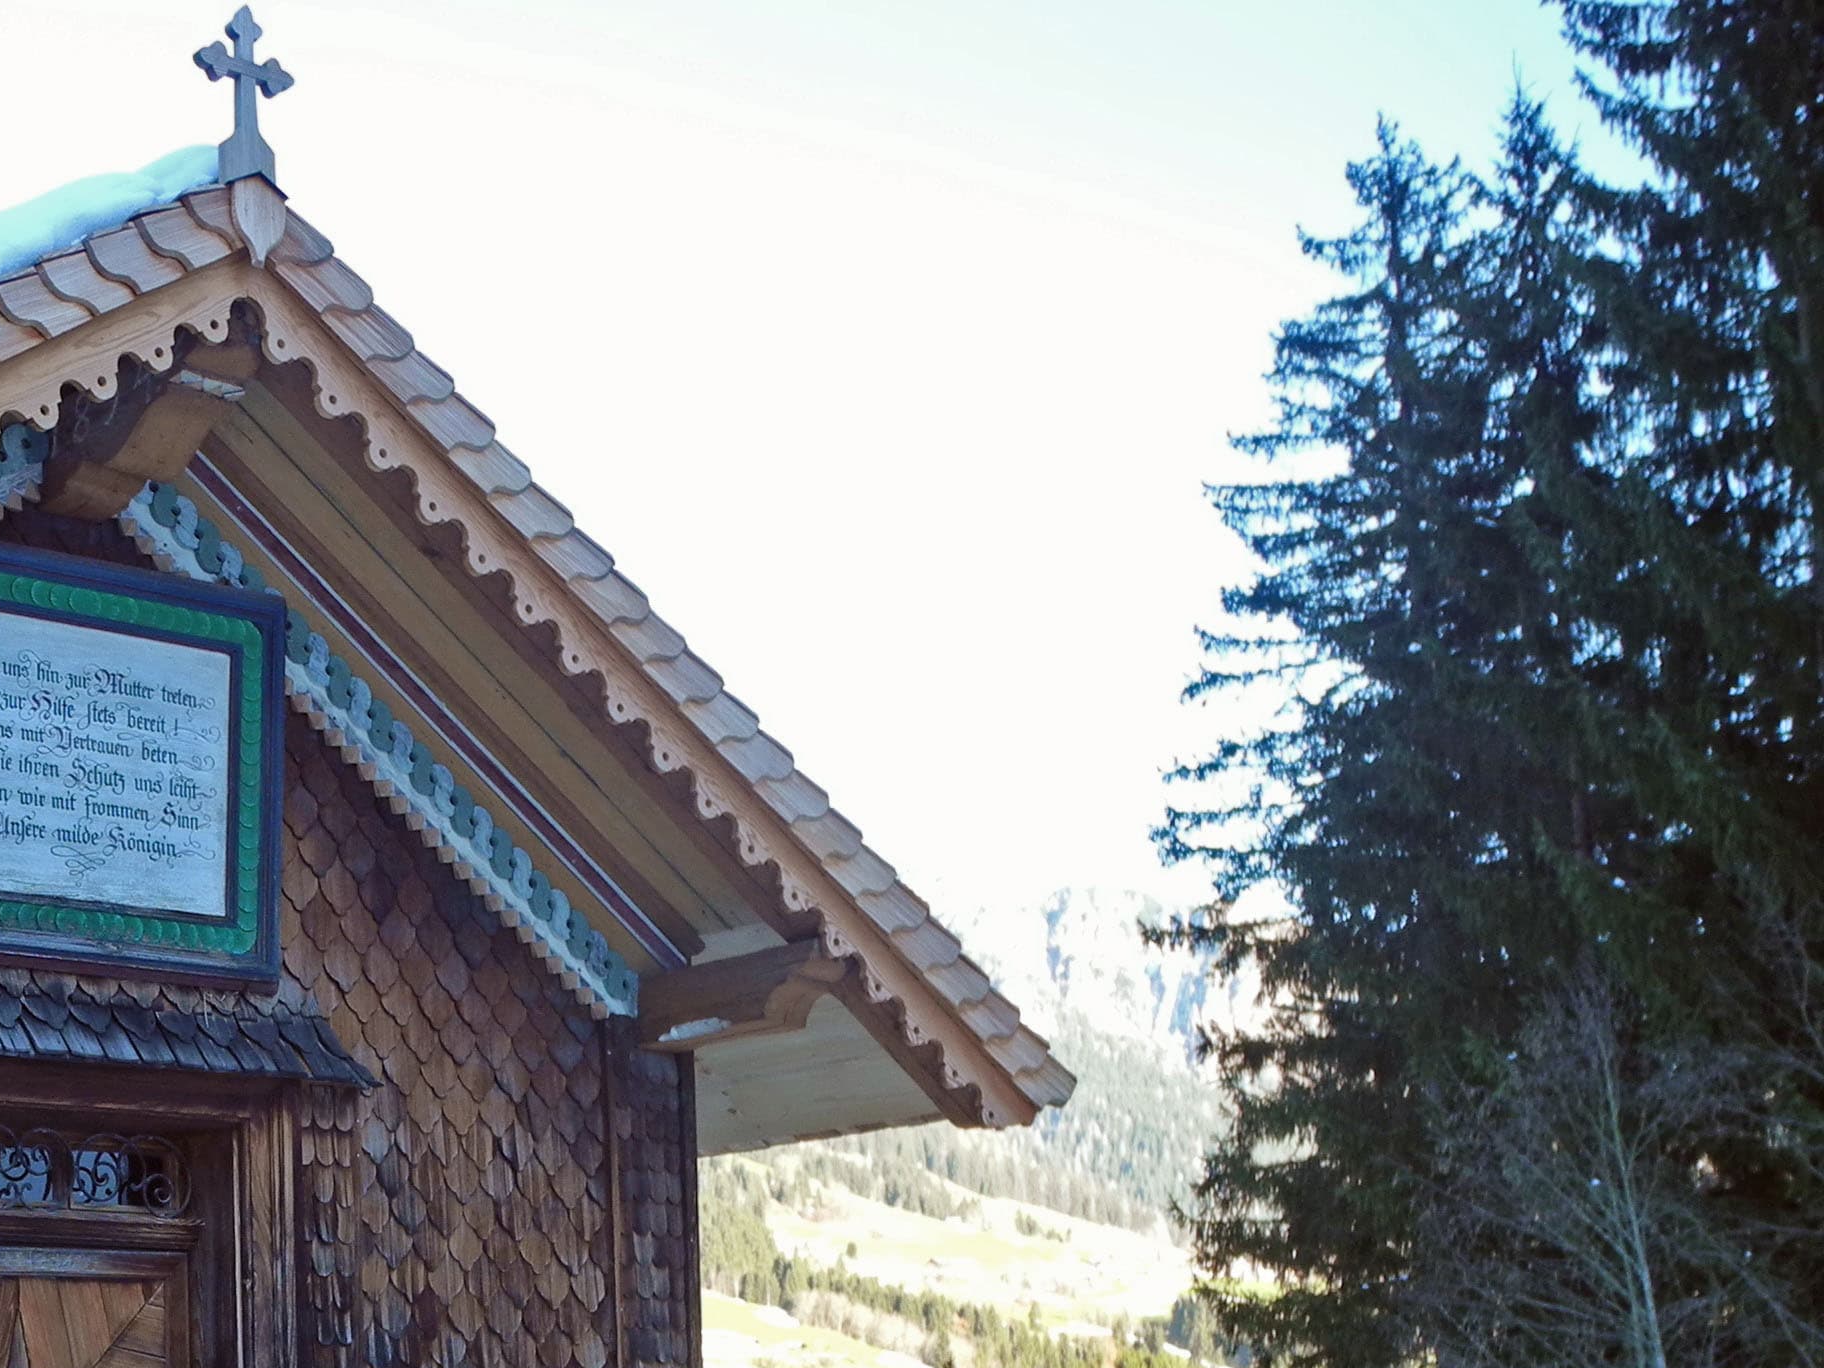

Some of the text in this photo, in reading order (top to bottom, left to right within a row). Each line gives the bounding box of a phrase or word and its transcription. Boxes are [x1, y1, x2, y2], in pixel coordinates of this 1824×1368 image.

[0, 660, 30, 678] uns
[36, 655, 61, 684] hin
[65, 672, 91, 690] zur
[93, 666, 155, 700] Mutter
[0, 689, 26, 711] zur
[30, 689, 75, 722] Hilfe
[79, 700, 116, 728] stets
[20, 727, 44, 743] mit
[45, 724, 131, 757] Vertrauen
[141, 740, 178, 765] beten
[17, 753, 60, 778] ihren
[69, 757, 126, 795] Schutz
[134, 777, 163, 794] uns
[169, 773, 199, 801] leiht
[18, 787, 46, 807] wir
[52, 792, 77, 811] mit
[84, 792, 150, 822] frommen
[160, 801, 199, 831] Sinn
[52, 823, 101, 846] milde
